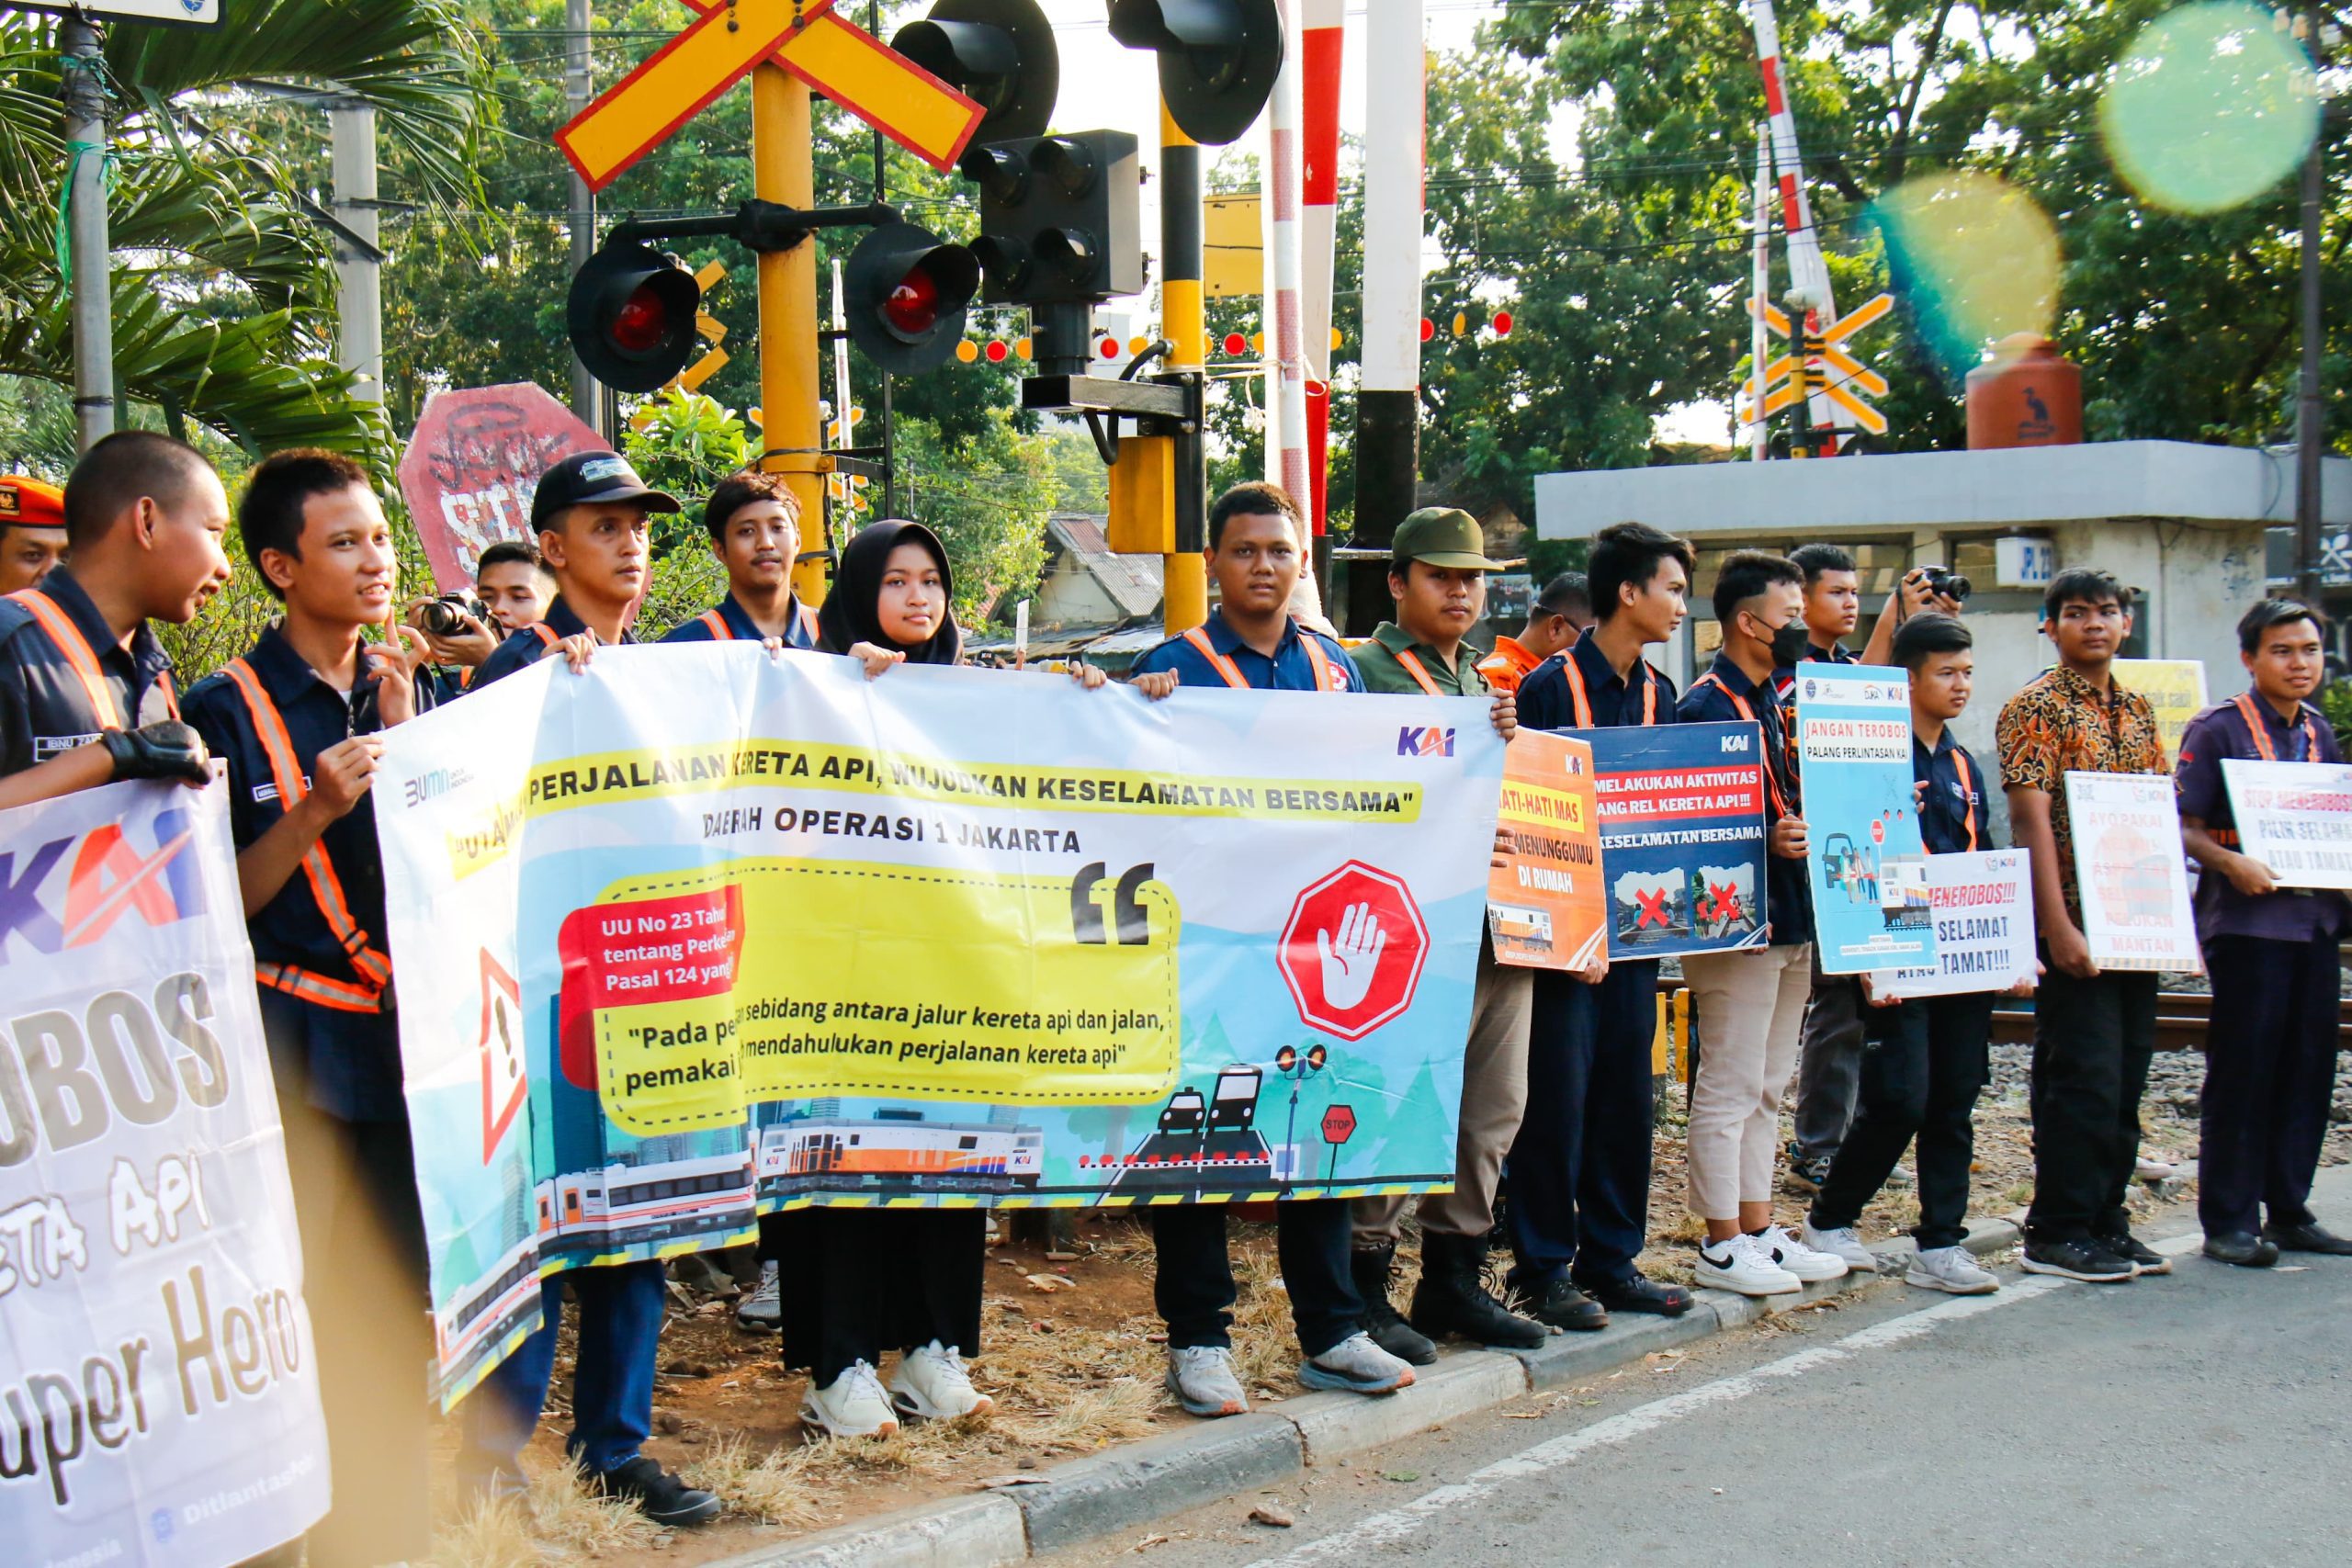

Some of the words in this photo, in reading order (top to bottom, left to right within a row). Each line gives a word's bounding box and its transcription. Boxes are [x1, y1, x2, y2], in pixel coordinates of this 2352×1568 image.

[1396, 726, 1456, 757] KAI
[1720, 734, 1749, 752] KAI
[1805, 722, 1854, 740] JANGAN
[1857, 723, 1907, 739] TEROBOS
[47, 738, 74, 750] IBNU
[1806, 746, 1841, 759] PALANG
[1842, 747, 1895, 760] PERLINTASAN
[1565, 753, 1584, 775] KAI
[529, 752, 726, 805] PERJALANAN
[730, 750, 809, 777] KERETA
[819, 754, 883, 789] API,
[890, 761, 1026, 799] WUJUDKAN
[1036, 776, 1256, 809] KESELAMATAN
[1264, 788, 1414, 813] BERSAMA"
[1594, 774, 1684, 794] MELAKUKAN
[1685, 771, 1758, 789] AKTIVITAS
[1554, 798, 1579, 823] MAS
[1629, 799, 1657, 815] REL
[1658, 796, 1714, 812] KERETA
[1715, 794, 1738, 809] API
[702, 806, 763, 839] DAERAH
[775, 807, 924, 842] OPERASI
[934, 820, 949, 844] 1
[956, 823, 1081, 853] JAKARTA
[1701, 825, 1763, 844] BERSAMA
[1514, 832, 1594, 866] MENUNGGUMU
[0, 809, 209, 967] KAI
[1517, 864, 1532, 888] DI
[1532, 867, 1574, 895] RUMAH
[602, 919, 632, 937] UU
[638, 917, 666, 934] No
[671, 912, 694, 930] 23
[1939, 916, 2008, 942] SELAMAT
[604, 942, 684, 964] tentang
[2111, 937, 2176, 953] MANTAN
[1940, 949, 2010, 976] TAMAT!!!
[605, 969, 660, 991] Pasal
[664, 966, 698, 986] 124
[628, 1021, 707, 1050] "Pada
[745, 997, 828, 1024] sebidang
[831, 1000, 910, 1022] antara
[911, 1003, 967, 1029] jalur
[971, 1006, 1041, 1030] kereta
[1046, 1010, 1072, 1035] api
[1076, 1010, 1107, 1030] dan
[1110, 1009, 1164, 1035] jalan,
[626, 1054, 736, 1097] pemakai
[745, 1032, 893, 1058] mendahulukan
[898, 1040, 1021, 1066] perjalanan
[1026, 1043, 1087, 1065] kereta
[1325, 1119, 1351, 1130] STOP
[109, 1150, 212, 1257] API
[161, 1264, 300, 1416] Hero
